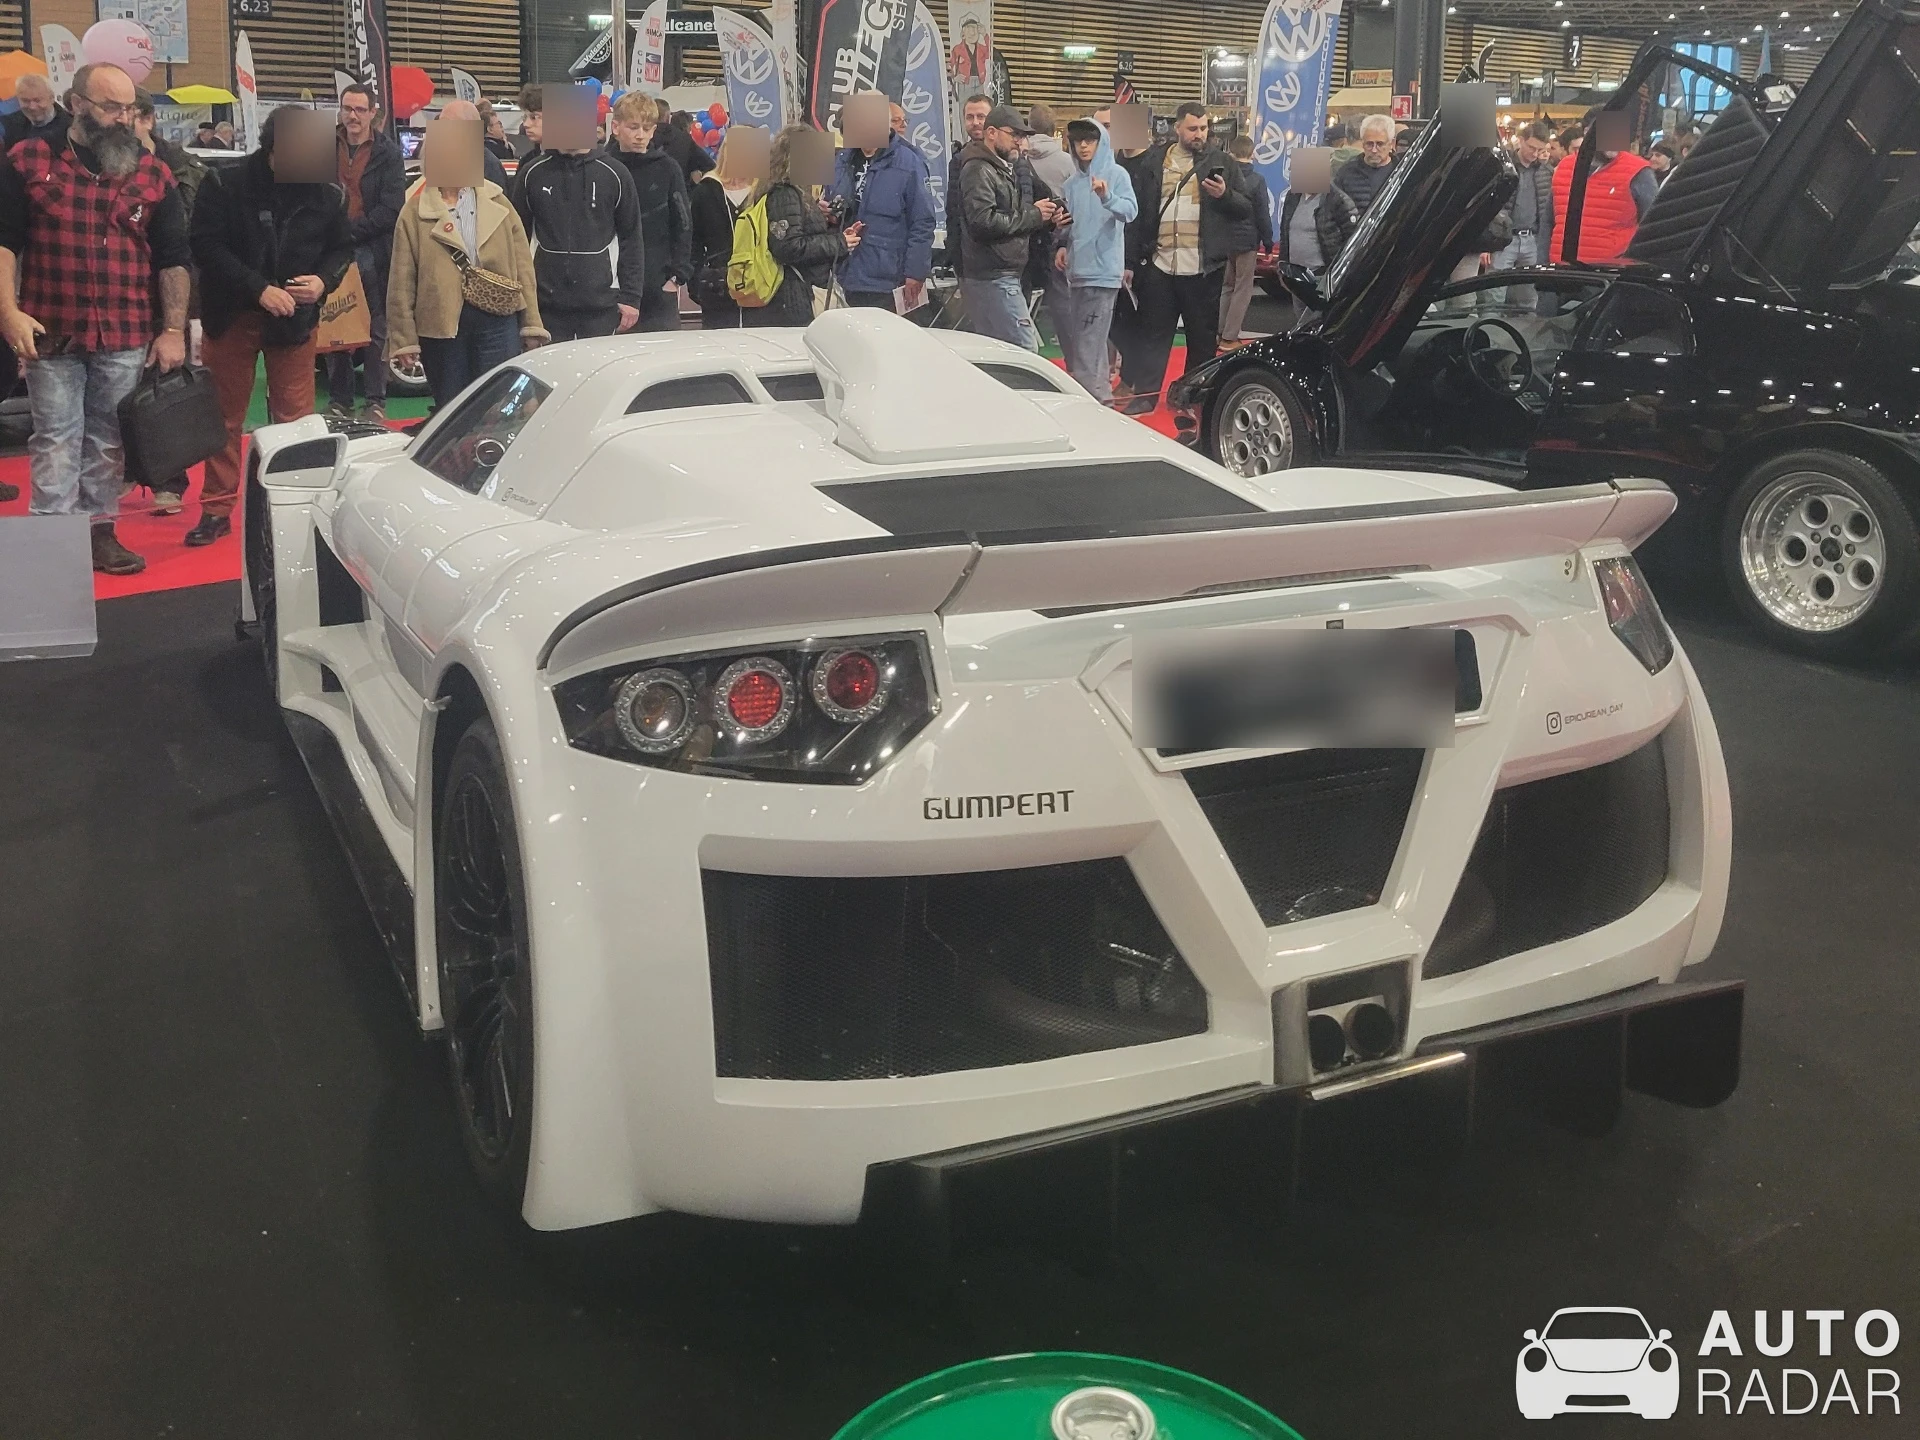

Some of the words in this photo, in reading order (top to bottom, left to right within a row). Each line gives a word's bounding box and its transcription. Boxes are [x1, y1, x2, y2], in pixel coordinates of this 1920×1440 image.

[240, 0, 270, 13] 6.23
[665, 18, 717, 32] ulcane
[1118, 61, 1133, 71] 6.26
[1210, 58, 1246, 68] Pioneer
[1564, 702, 1624, 725] EPICUREAN_DAY
[923, 789, 1075, 820] GUMPERT
